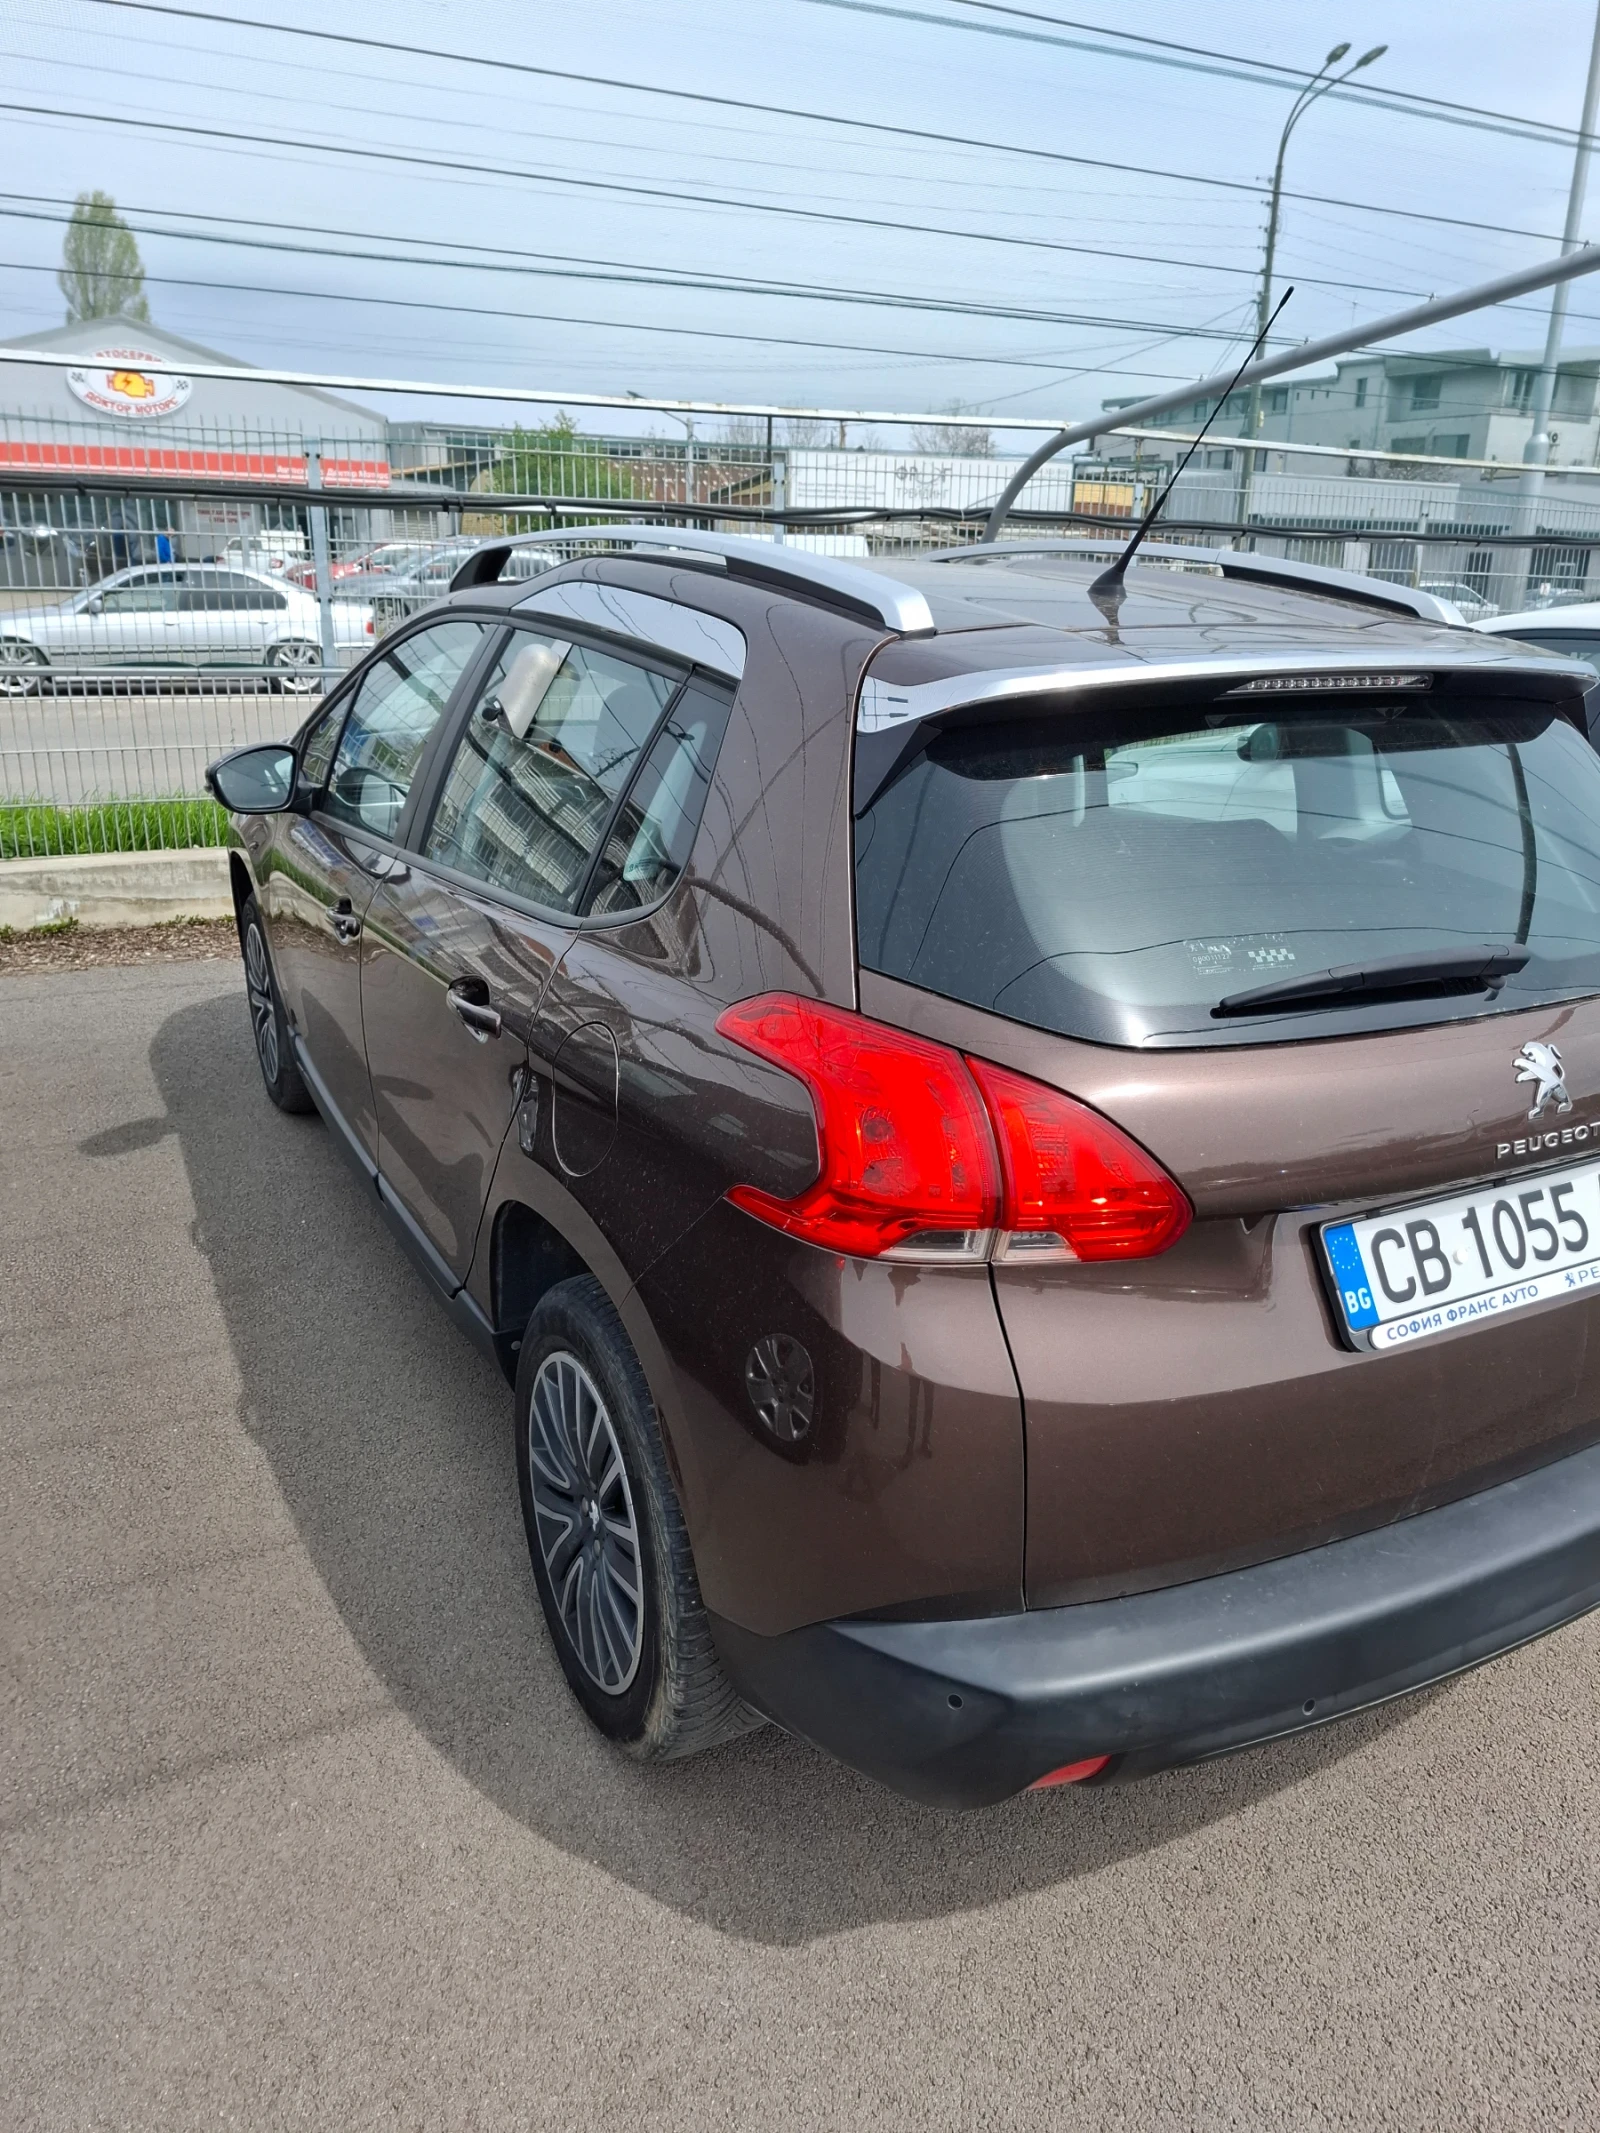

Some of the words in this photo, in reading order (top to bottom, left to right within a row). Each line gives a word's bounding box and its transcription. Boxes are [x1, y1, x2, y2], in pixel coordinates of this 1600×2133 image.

[84, 391, 131, 412] ДОКТОР
[135, 397, 178, 414] МОТОРС
[1497, 1121, 1600, 1159] PEUGEOT
[1371, 1219, 1452, 1304] CB
[1462, 1181, 1588, 1278] 1055
[1345, 1287, 1372, 1314] BG
[1387, 1313, 1442, 1340] СОФИЯ
[1446, 1296, 1499, 1322] ФРАНС
[1502, 1284, 1539, 1306] АУТО
